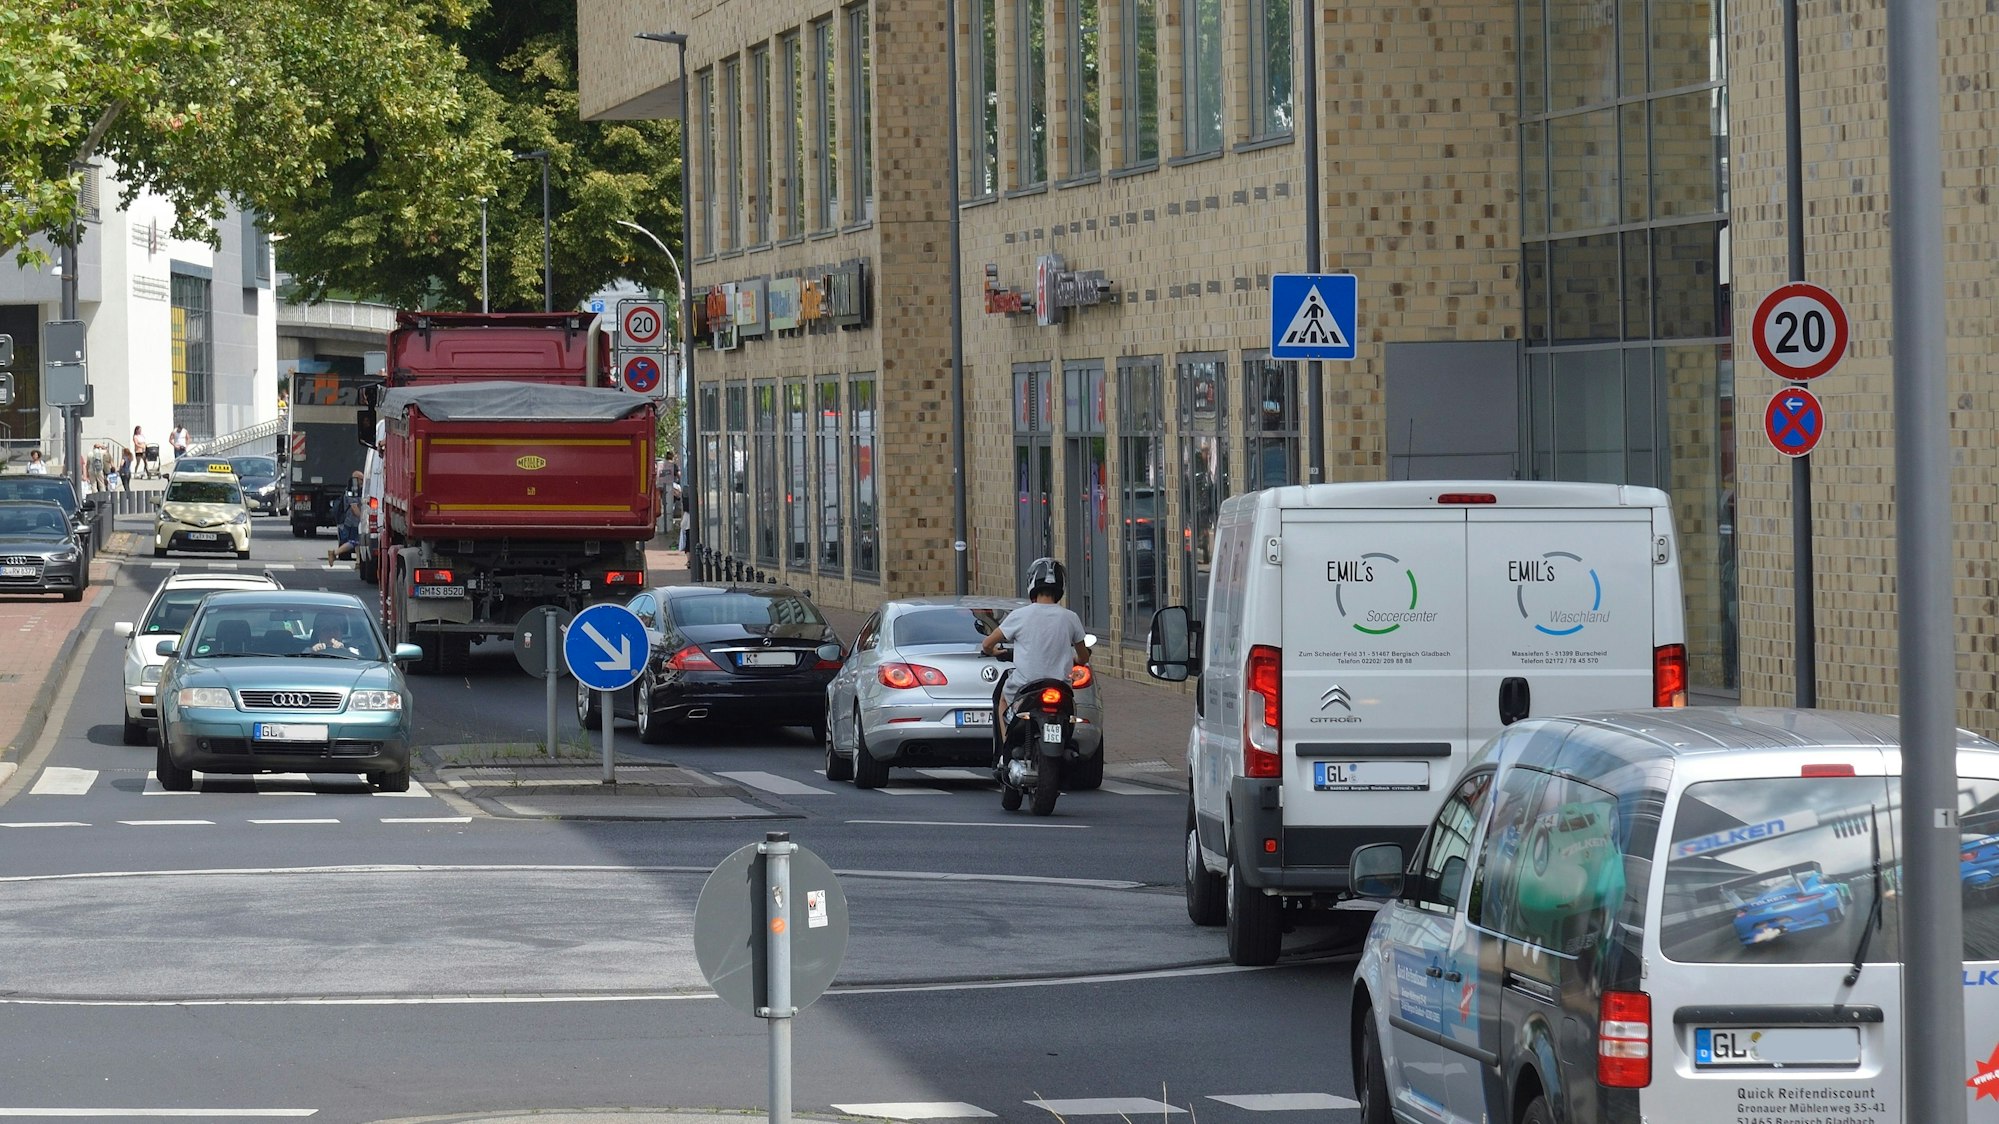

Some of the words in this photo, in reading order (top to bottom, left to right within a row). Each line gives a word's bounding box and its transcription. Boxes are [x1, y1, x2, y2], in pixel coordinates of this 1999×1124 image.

[633, 317, 653, 332] 20
[1775, 310, 1826, 353] 20
[420, 587, 431, 596] GM
[443, 587, 464, 596] 8520
[1366, 609, 1438, 623] Soccercenter
[1549, 610, 1611, 623] Waschland
[746, 654, 753, 664] K
[1391, 651, 1420, 659] Bergisch
[963, 712, 979, 723] GL
[262, 725, 278, 737] GL
[1046, 724, 1060, 733] 448
[1046, 734, 1060, 743] JSC
[1327, 765, 1348, 783] GL
[1676, 818, 1786, 857] FALKEN
[1713, 1033, 1747, 1058] GL
[1737, 1087, 1775, 1099] Quick
[1778, 1087, 1876, 1099] Reifendiscount
[1737, 1103, 1787, 1113] Gronauer
[1853, 1102, 1886, 1113] 35-41
